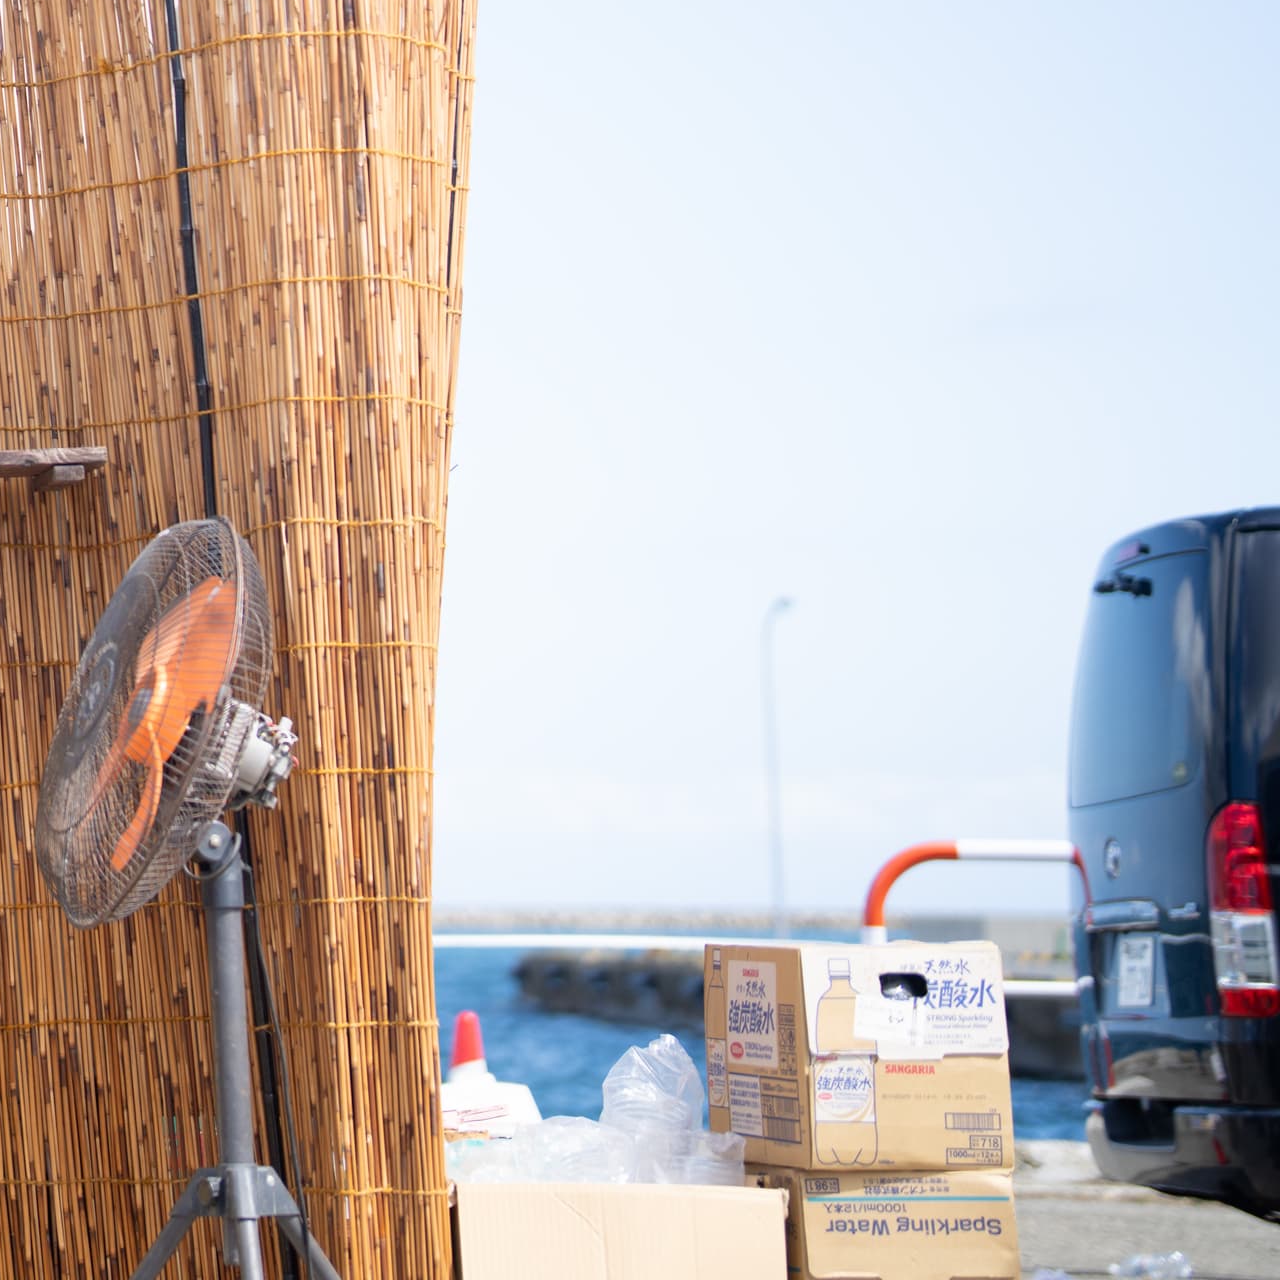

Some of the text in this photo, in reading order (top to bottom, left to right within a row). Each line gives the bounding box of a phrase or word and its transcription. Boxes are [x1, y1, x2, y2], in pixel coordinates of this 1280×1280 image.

[728, 1000, 775, 1035] 強炭酸水
[885, 1063, 936, 1075] SANGARIA
[817, 1076, 872, 1091] 強炭酸水
[980, 1137, 1000, 1148] 718
[826, 1216, 1002, 1236] Sparkling Water
